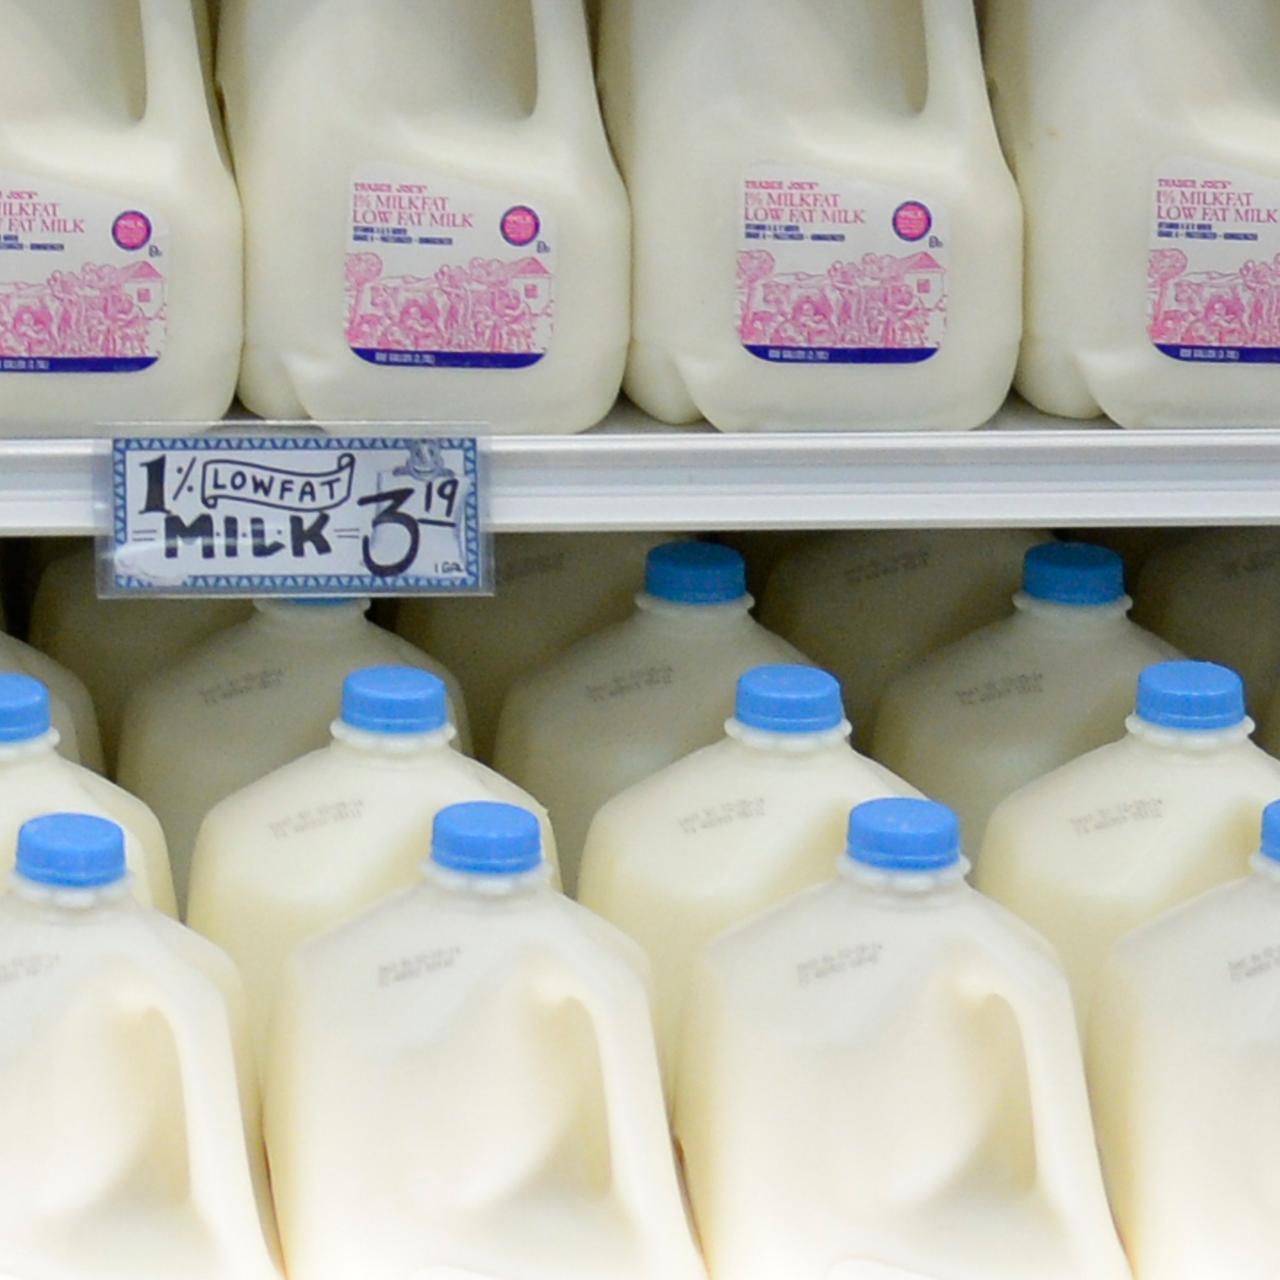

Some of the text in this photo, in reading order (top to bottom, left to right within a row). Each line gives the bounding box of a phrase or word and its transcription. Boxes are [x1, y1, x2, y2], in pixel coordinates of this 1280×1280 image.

[8, 219, 35, 233] FAT
[41, 219, 85, 233] MILK
[138, 454, 342, 515] 1% LOWFAT
